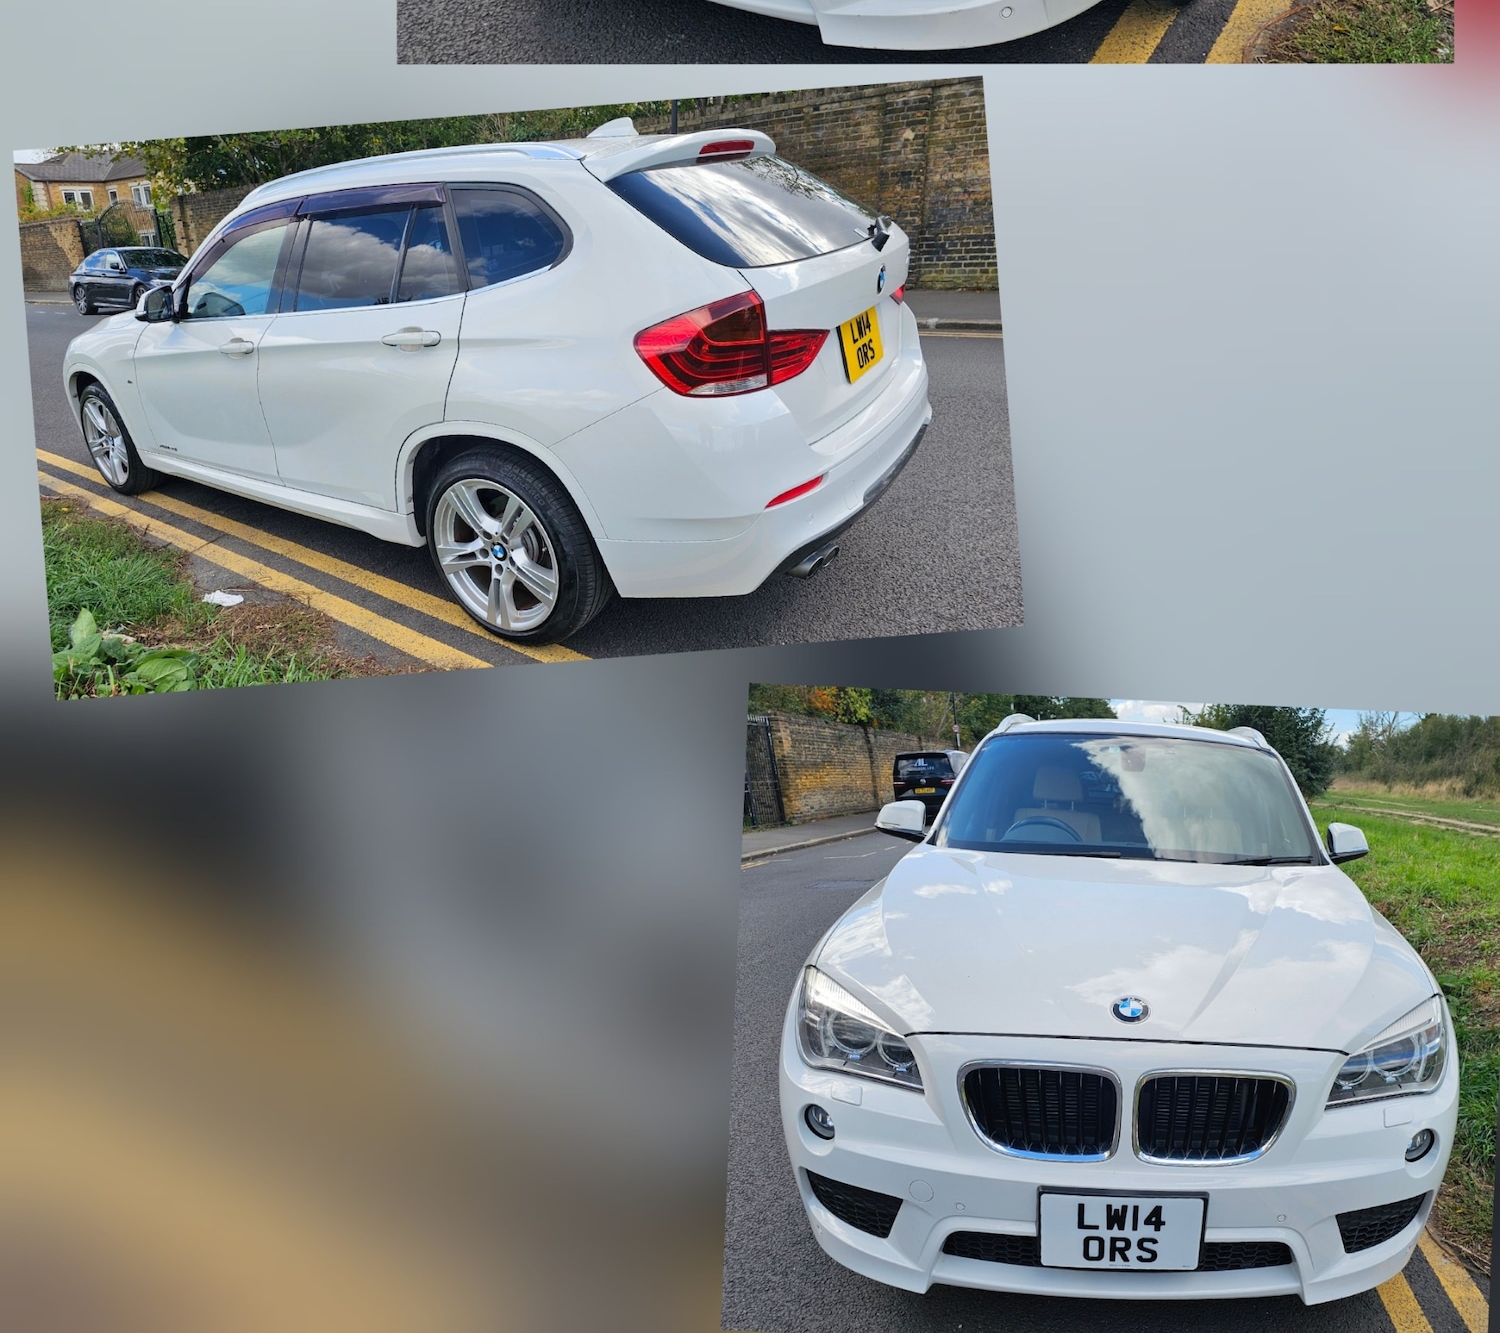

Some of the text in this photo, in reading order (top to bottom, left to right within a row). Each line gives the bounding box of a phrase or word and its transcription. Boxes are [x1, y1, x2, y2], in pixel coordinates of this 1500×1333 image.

[850, 311, 872, 344] LW14
[857, 339, 875, 369] ORS
[1077, 1203, 1166, 1232] LW14
[1083, 1236, 1159, 1263] ORS
